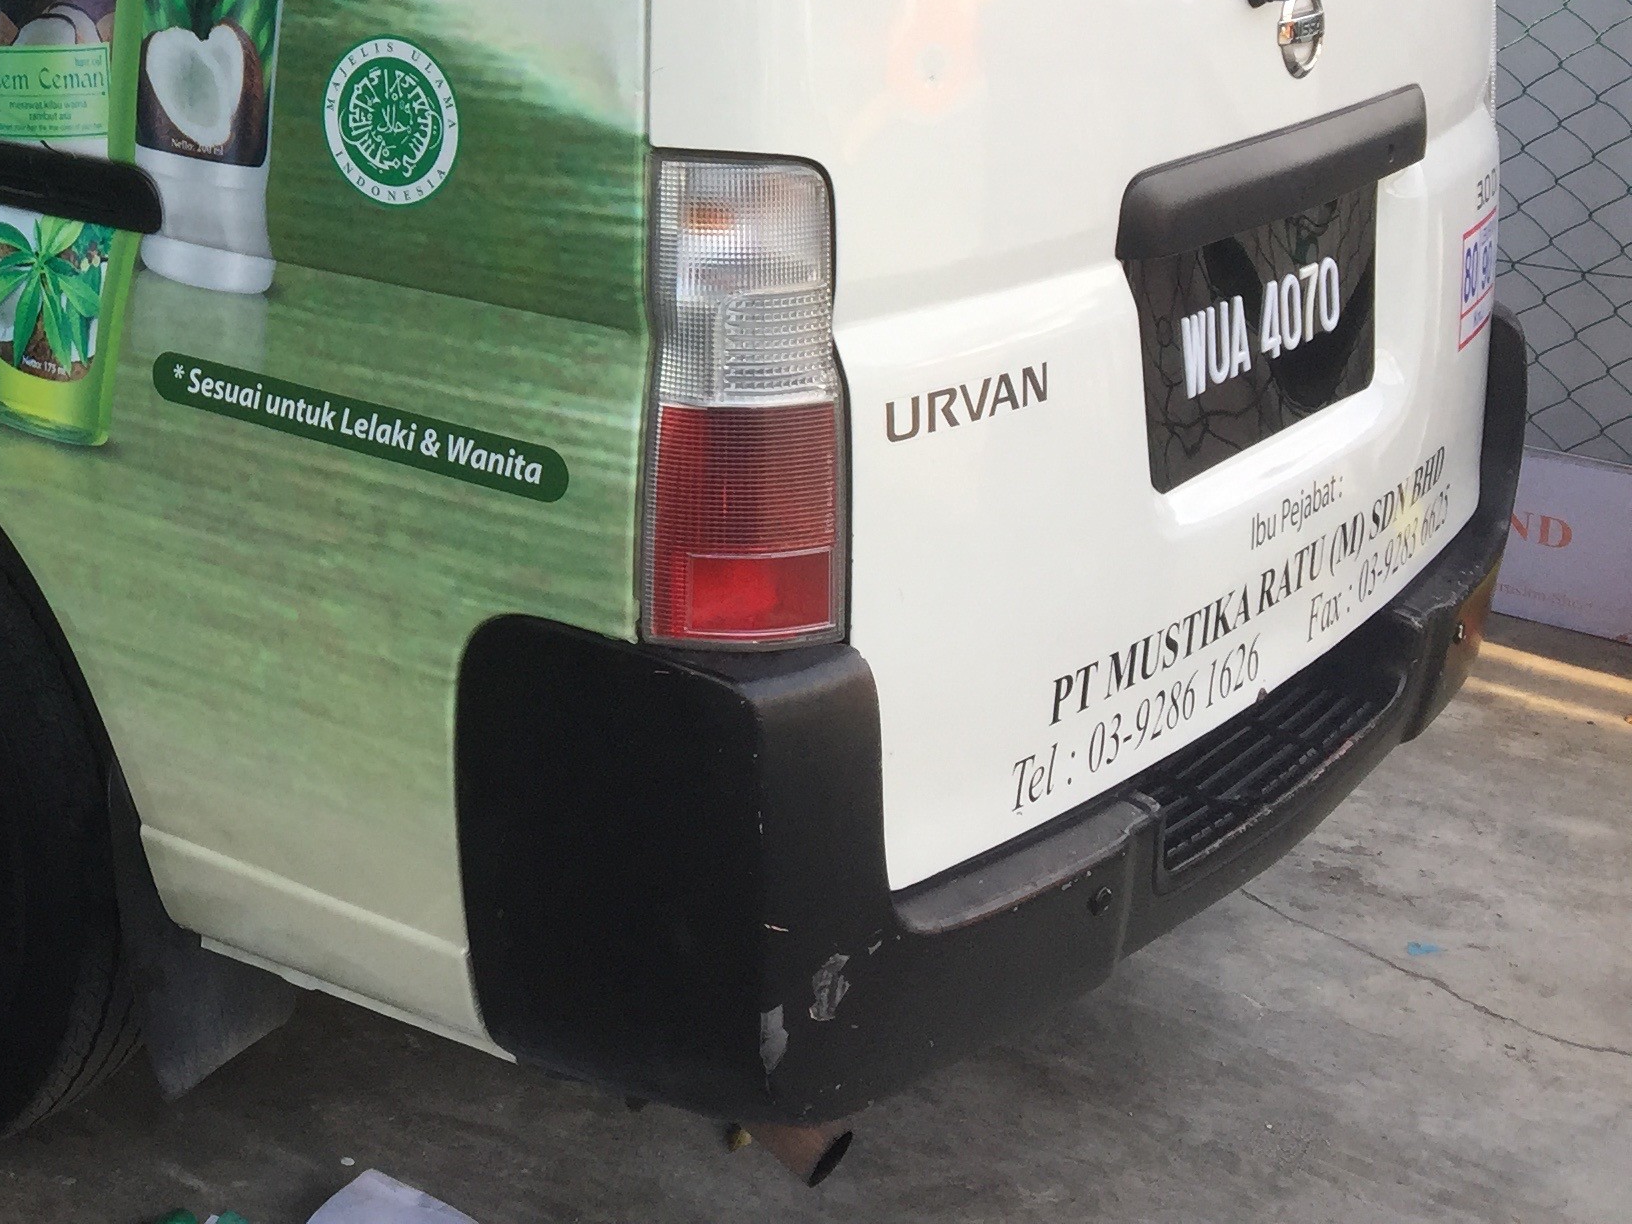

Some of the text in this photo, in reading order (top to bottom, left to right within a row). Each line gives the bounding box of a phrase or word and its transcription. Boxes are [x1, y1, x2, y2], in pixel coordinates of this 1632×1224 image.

[39, 67, 105, 90] Ceman
[326, 42, 394, 112] MAJELIS
[410, 50, 457, 129] ULAMA
[335, 150, 446, 202] INDONESIA
[1181, 256, 1340, 399] WUA 4070
[186, 367, 543, 485] Sesuai untuk Lelaki & Wanita
[886, 361, 1048, 443] URVAN
[1251, 513, 1277, 550] Ibu
[1281, 476, 1336, 533] Pejabat
[1048, 445, 1445, 727] PT MUSTIKA RATU (M) SDN BHD
[1306, 591, 1342, 643] Fax
[1012, 742, 1058, 813] Tel
[1088, 669, 1199, 773] 03-9286
[1205, 632, 1260, 709] 1626
